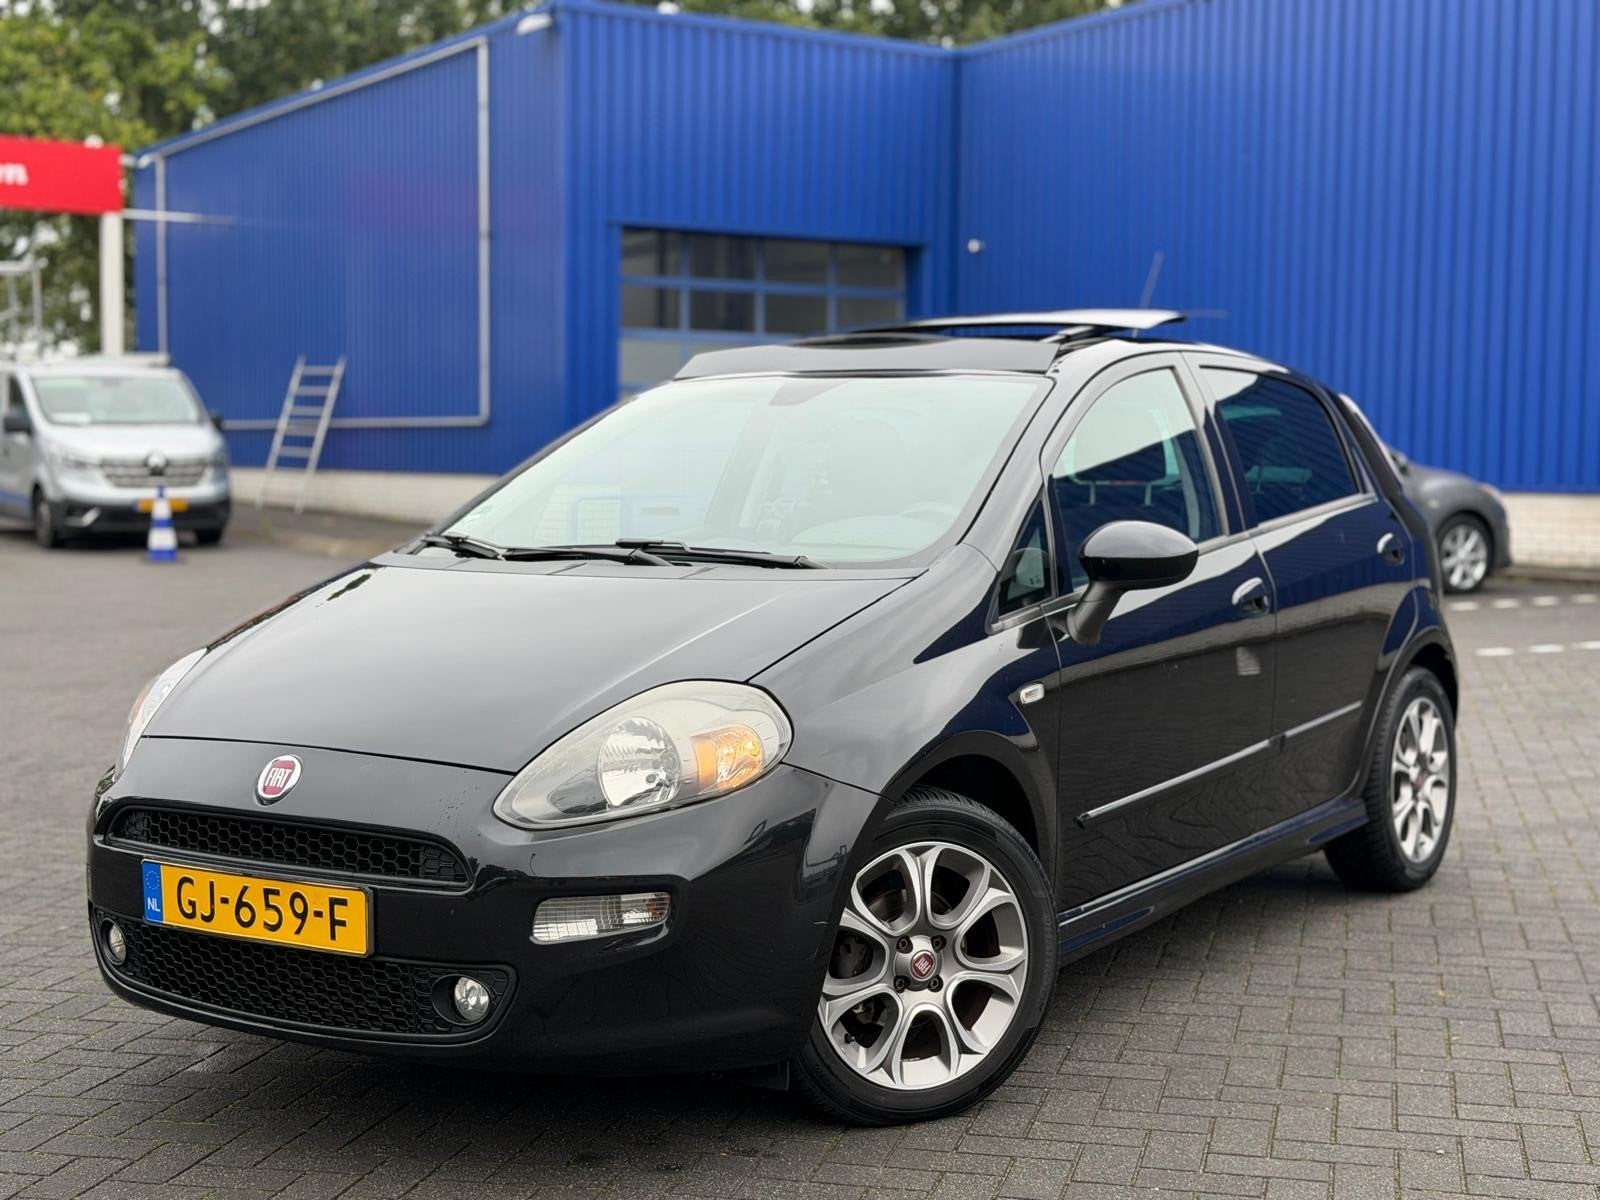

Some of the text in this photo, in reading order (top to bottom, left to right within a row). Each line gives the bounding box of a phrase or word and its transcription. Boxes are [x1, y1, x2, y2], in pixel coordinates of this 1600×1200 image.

[264, 767, 293, 788] FIAT
[147, 897, 161, 913] NL
[176, 876, 349, 941] GJ-659-F
